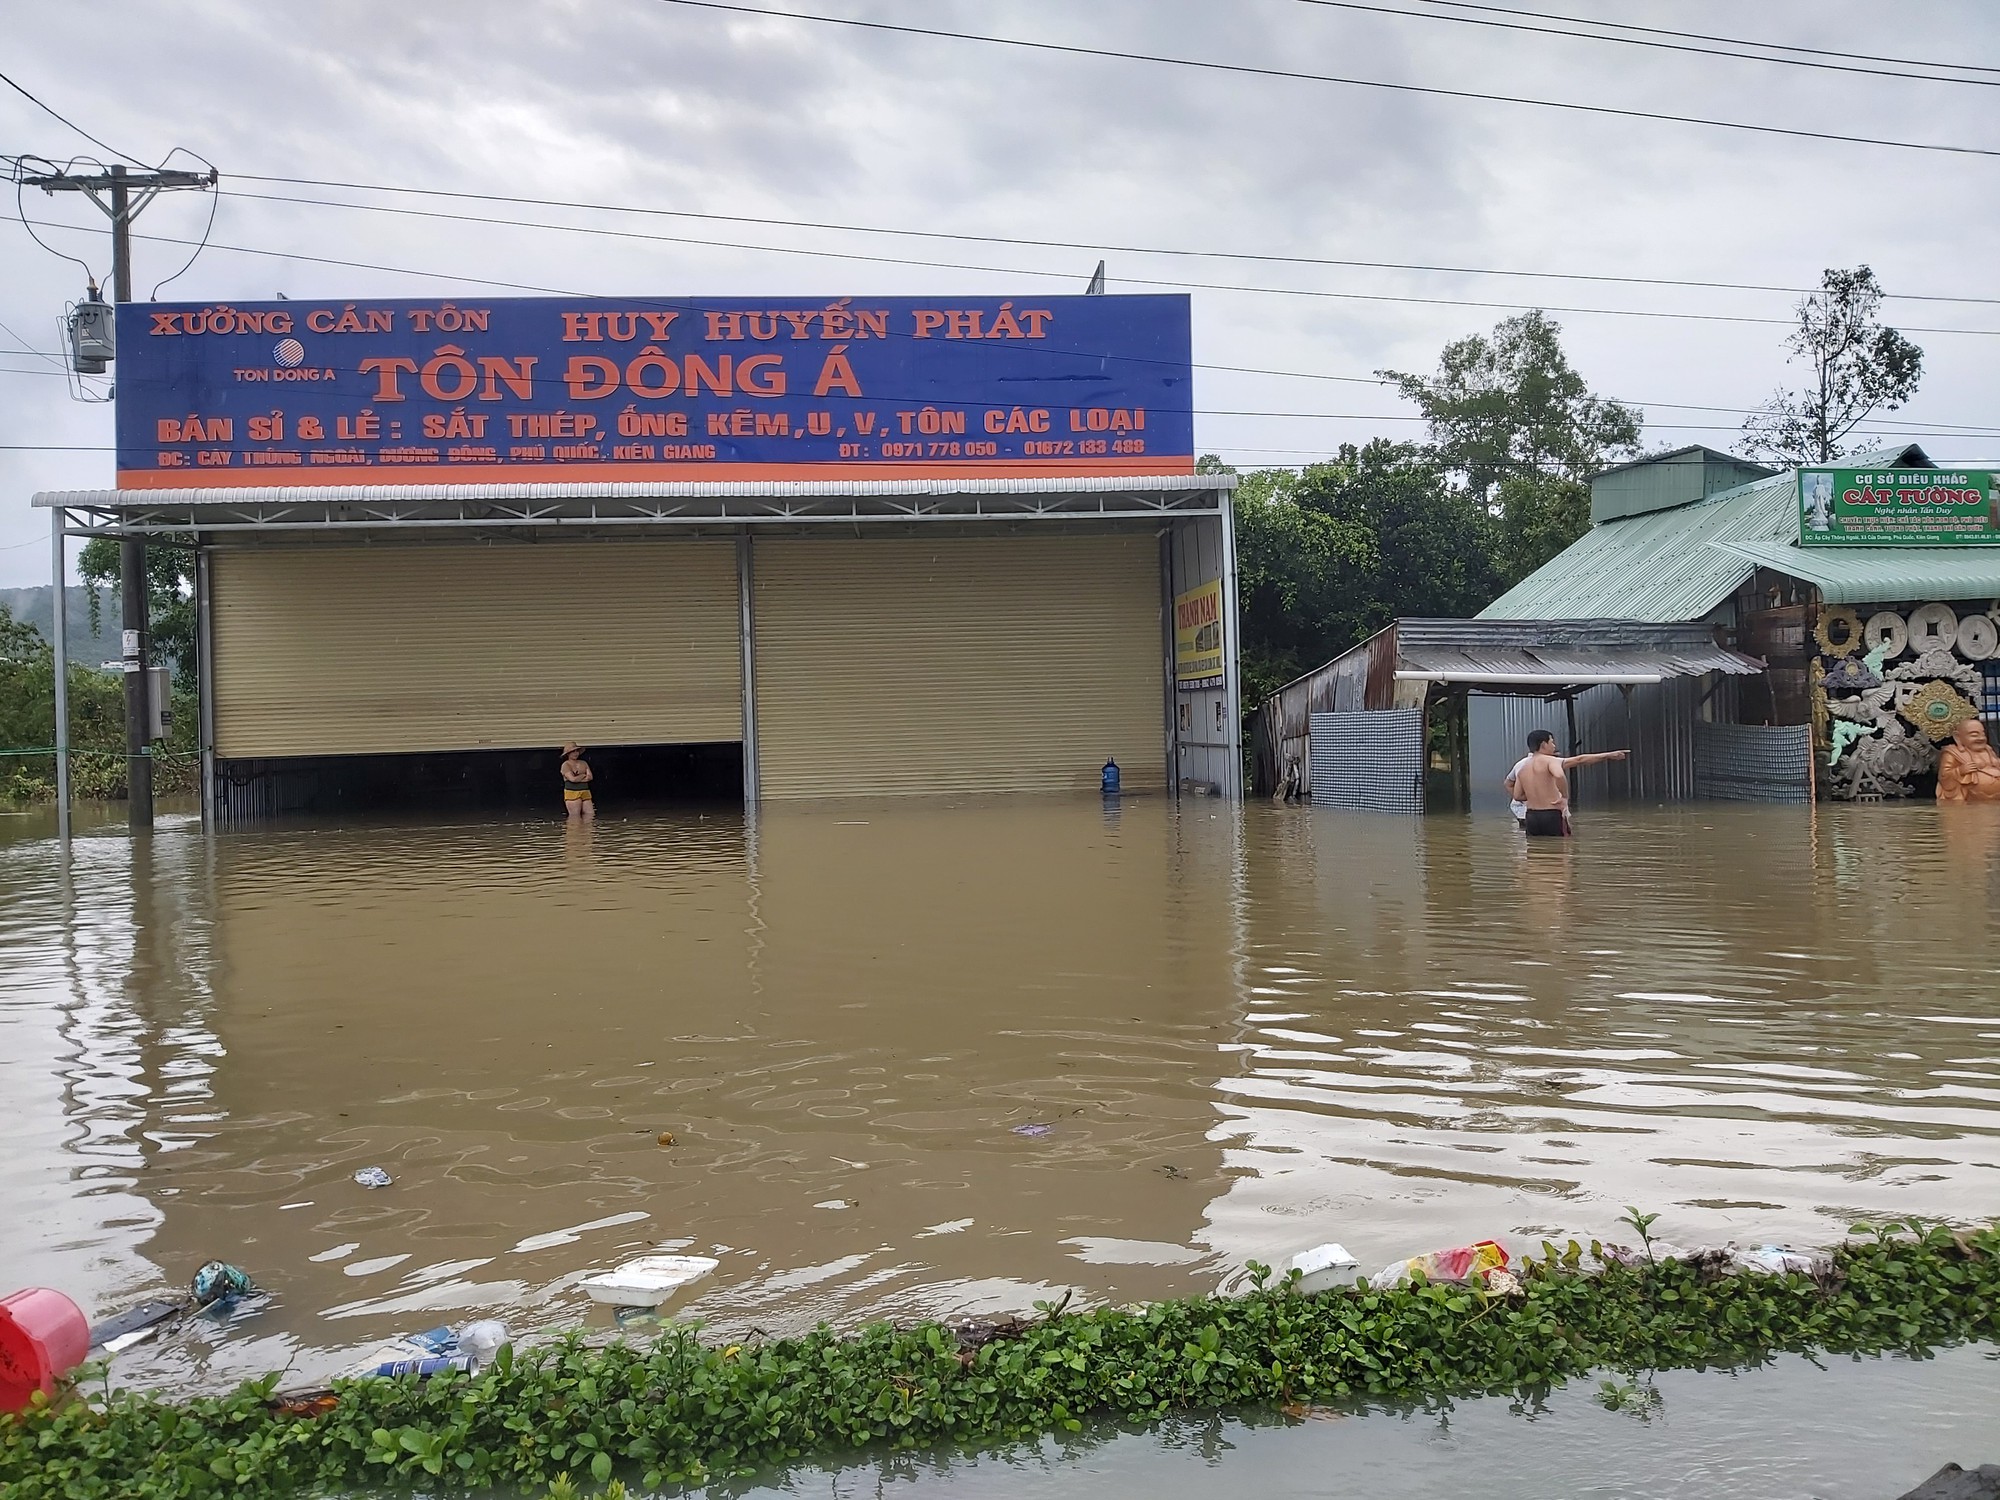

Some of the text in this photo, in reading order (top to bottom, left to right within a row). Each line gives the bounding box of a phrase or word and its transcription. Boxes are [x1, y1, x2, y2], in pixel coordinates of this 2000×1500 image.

[150, 304, 490, 335] XƯỞNG CÁN TÔN
[561, 297, 1052, 341] HUY HUYẾN PHÁT
[323, 368, 335, 381] A
[358, 344, 863, 402] TÔN ĐÔNG Á
[158, 414, 232, 442] BÁN
[249, 410, 283, 441] SỈ
[298, 416, 324, 440] &
[423, 406, 489, 439] SẮT
[506, 411, 606, 441] THÉP,
[618, 404, 687, 437] ỐNG
[983, 406, 1049, 433] CÁC
[1070, 408, 1145, 436] LOẠI
[613, 443, 655, 459] KIÊN
[663, 444, 716, 459] GIANG
[882, 442, 923, 457] 0971
[928, 442, 960, 456] 778
[965, 442, 996, 456] 050
[1855, 474, 1873, 485] CƠ
[1877, 473, 1894, 485] SỞ
[1843, 485, 1981, 505] CÁT TƯỜNG
[1874, 507, 1895, 515] Nghệ
[1936, 507, 1952, 515] Duy
[1200, 592, 1217, 623] NAM
